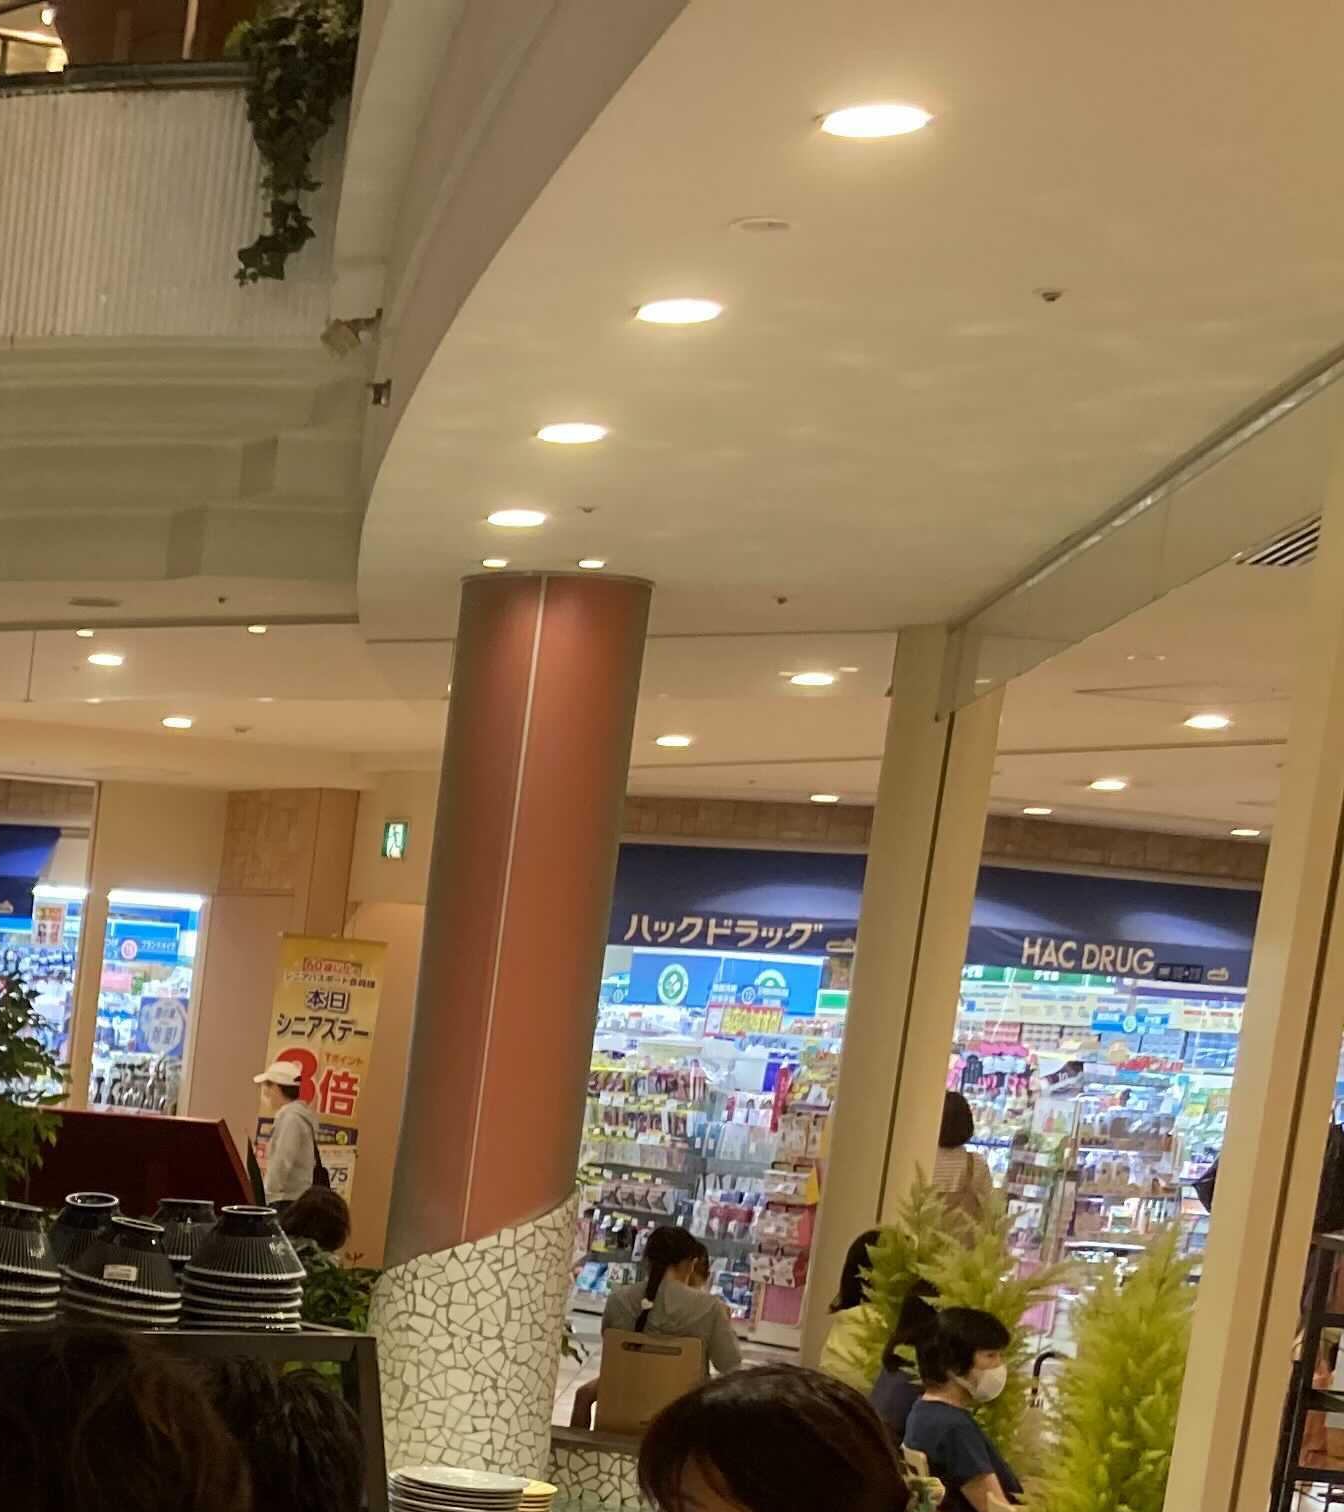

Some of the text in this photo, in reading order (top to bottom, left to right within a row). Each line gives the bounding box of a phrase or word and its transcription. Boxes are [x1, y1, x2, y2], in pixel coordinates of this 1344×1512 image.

[623, 913, 824, 950] ハックドラッグ
[1021, 936, 1077, 970] HAC
[1081, 943, 1155, 975] DRUG
[306, 988, 349, 1012] 本日
